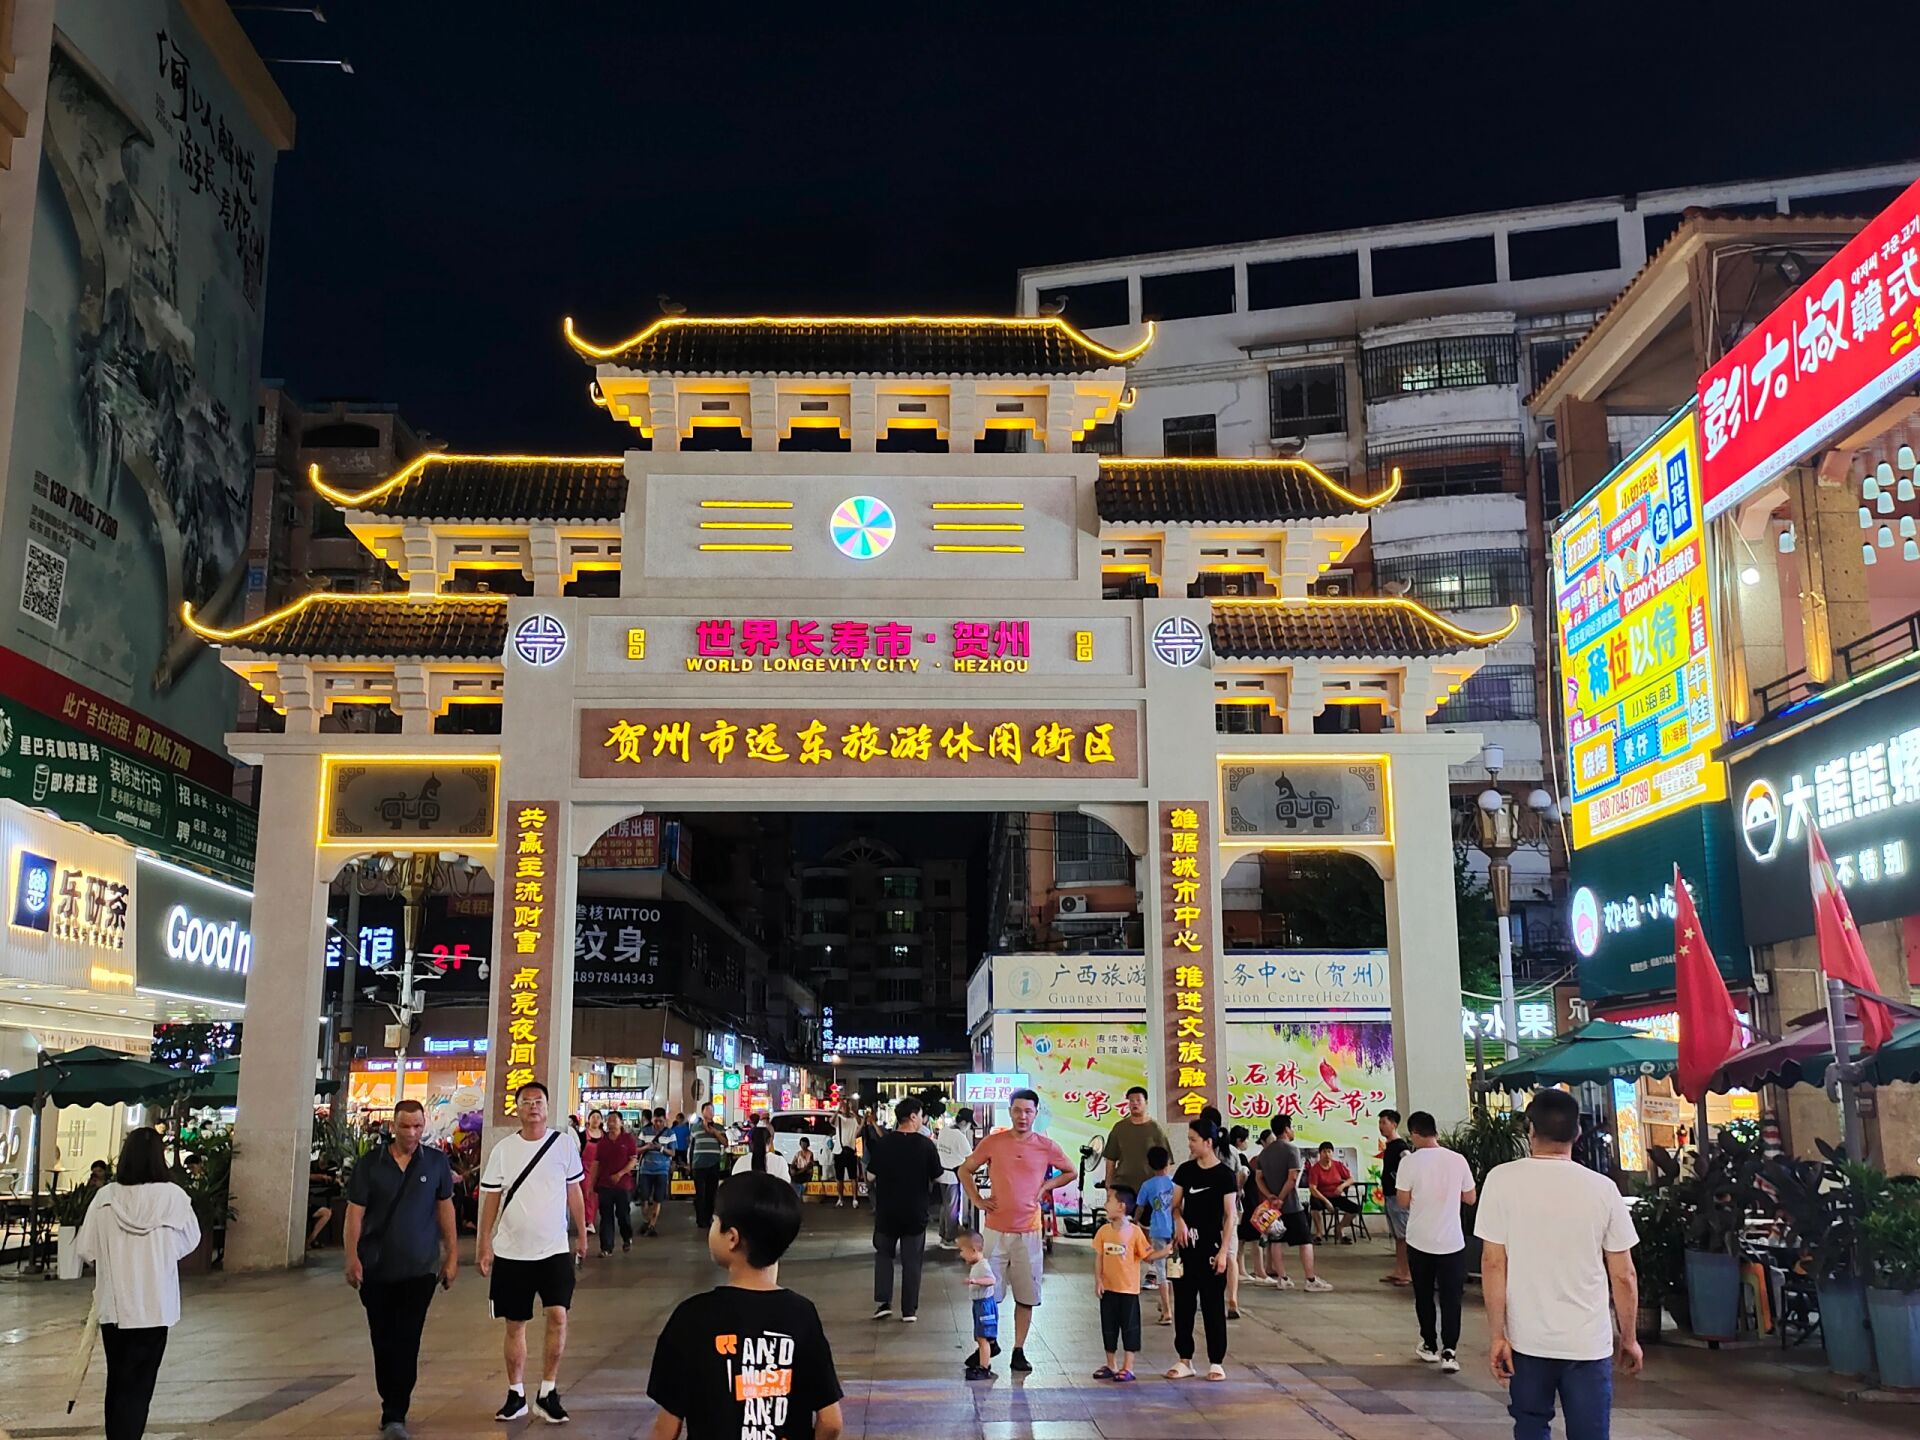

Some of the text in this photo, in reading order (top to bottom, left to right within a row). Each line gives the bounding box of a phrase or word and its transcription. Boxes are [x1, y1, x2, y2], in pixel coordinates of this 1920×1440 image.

[686, 658, 1029, 673] WORLD LONGEVITY CITY HEZHOU
[1688, 661, 1711, 727] 牛蛙
[19, 735, 100, 762] 星巴克咖啡服务
[603, 719, 1116, 765] 贺州市远东旅游休闲街区
[50, 772, 98, 795] 即将进驻
[109, 757, 162, 799] 装修进行中
[606, 906, 661, 922] TATTOO
[574, 923, 647, 963] 纹身
[432, 944, 470, 970] 2F
[504, 807, 548, 1117] 共赢主流财富 点亮夜间经
[1170, 807, 1208, 1116] 雄踞城市中心 推进文旅融合
[1224, 961, 1385, 988] 务中心（贺州）
[1048, 991, 1107, 1008] Guangxi
[742, 1338, 795, 1366] AND
[741, 1364, 792, 1386] MUST
[743, 1397, 789, 1426] AND
